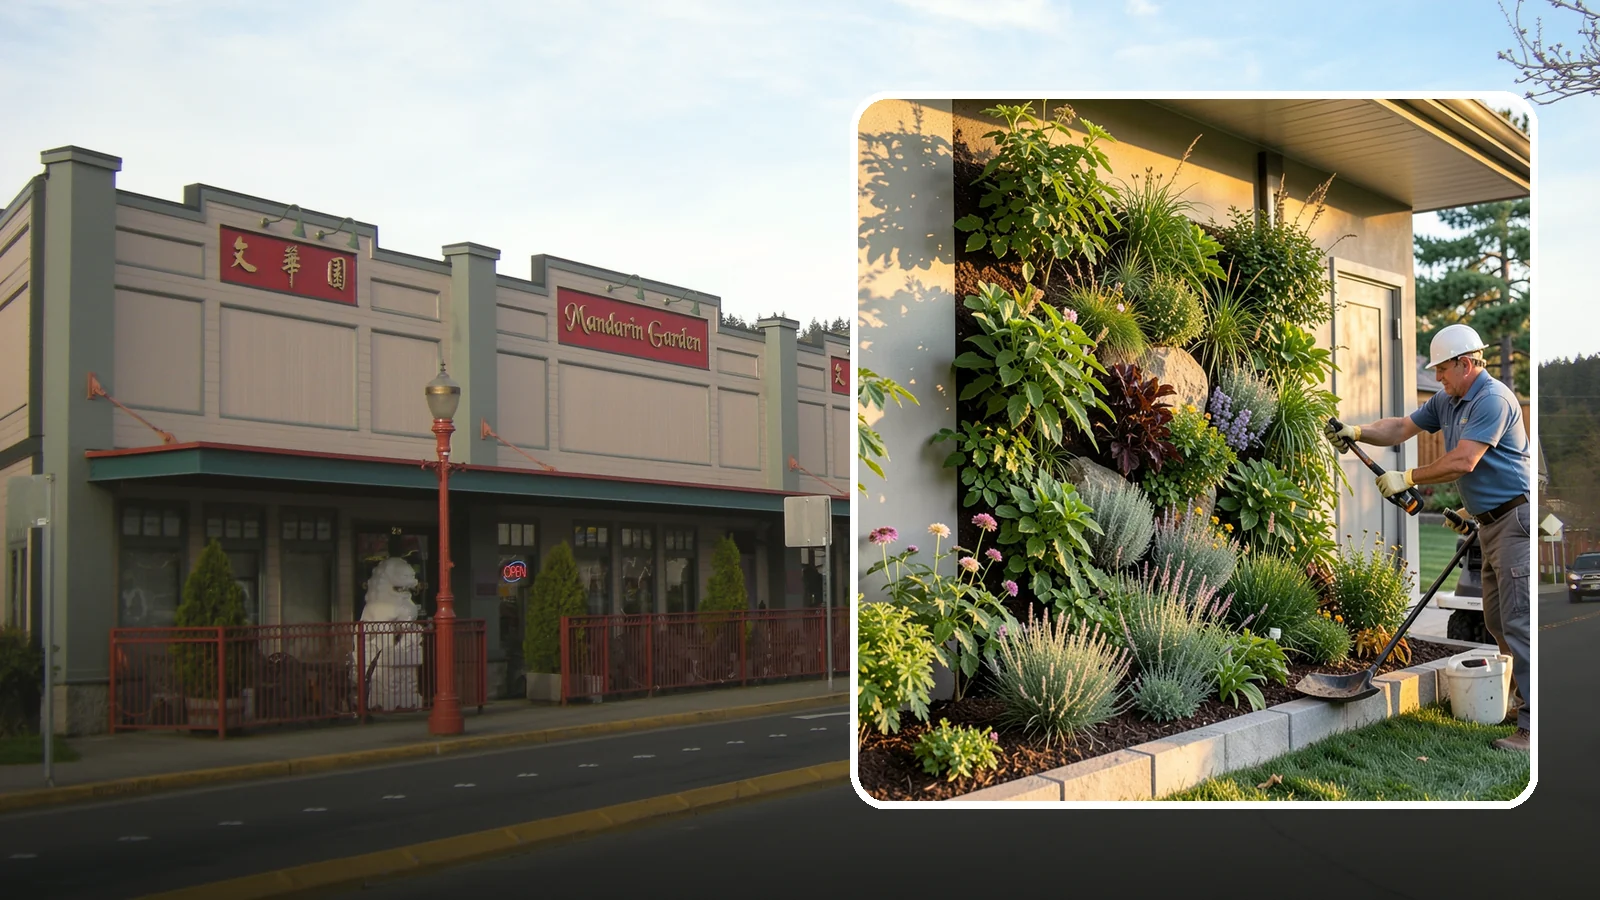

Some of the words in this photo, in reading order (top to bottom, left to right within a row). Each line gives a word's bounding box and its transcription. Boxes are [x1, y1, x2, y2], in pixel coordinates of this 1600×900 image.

[230, 235, 346, 291] 文華園
[564, 302, 644, 341] Mandarin
[647, 320, 701, 352] Garden
[503, 565, 527, 578] OPEN
